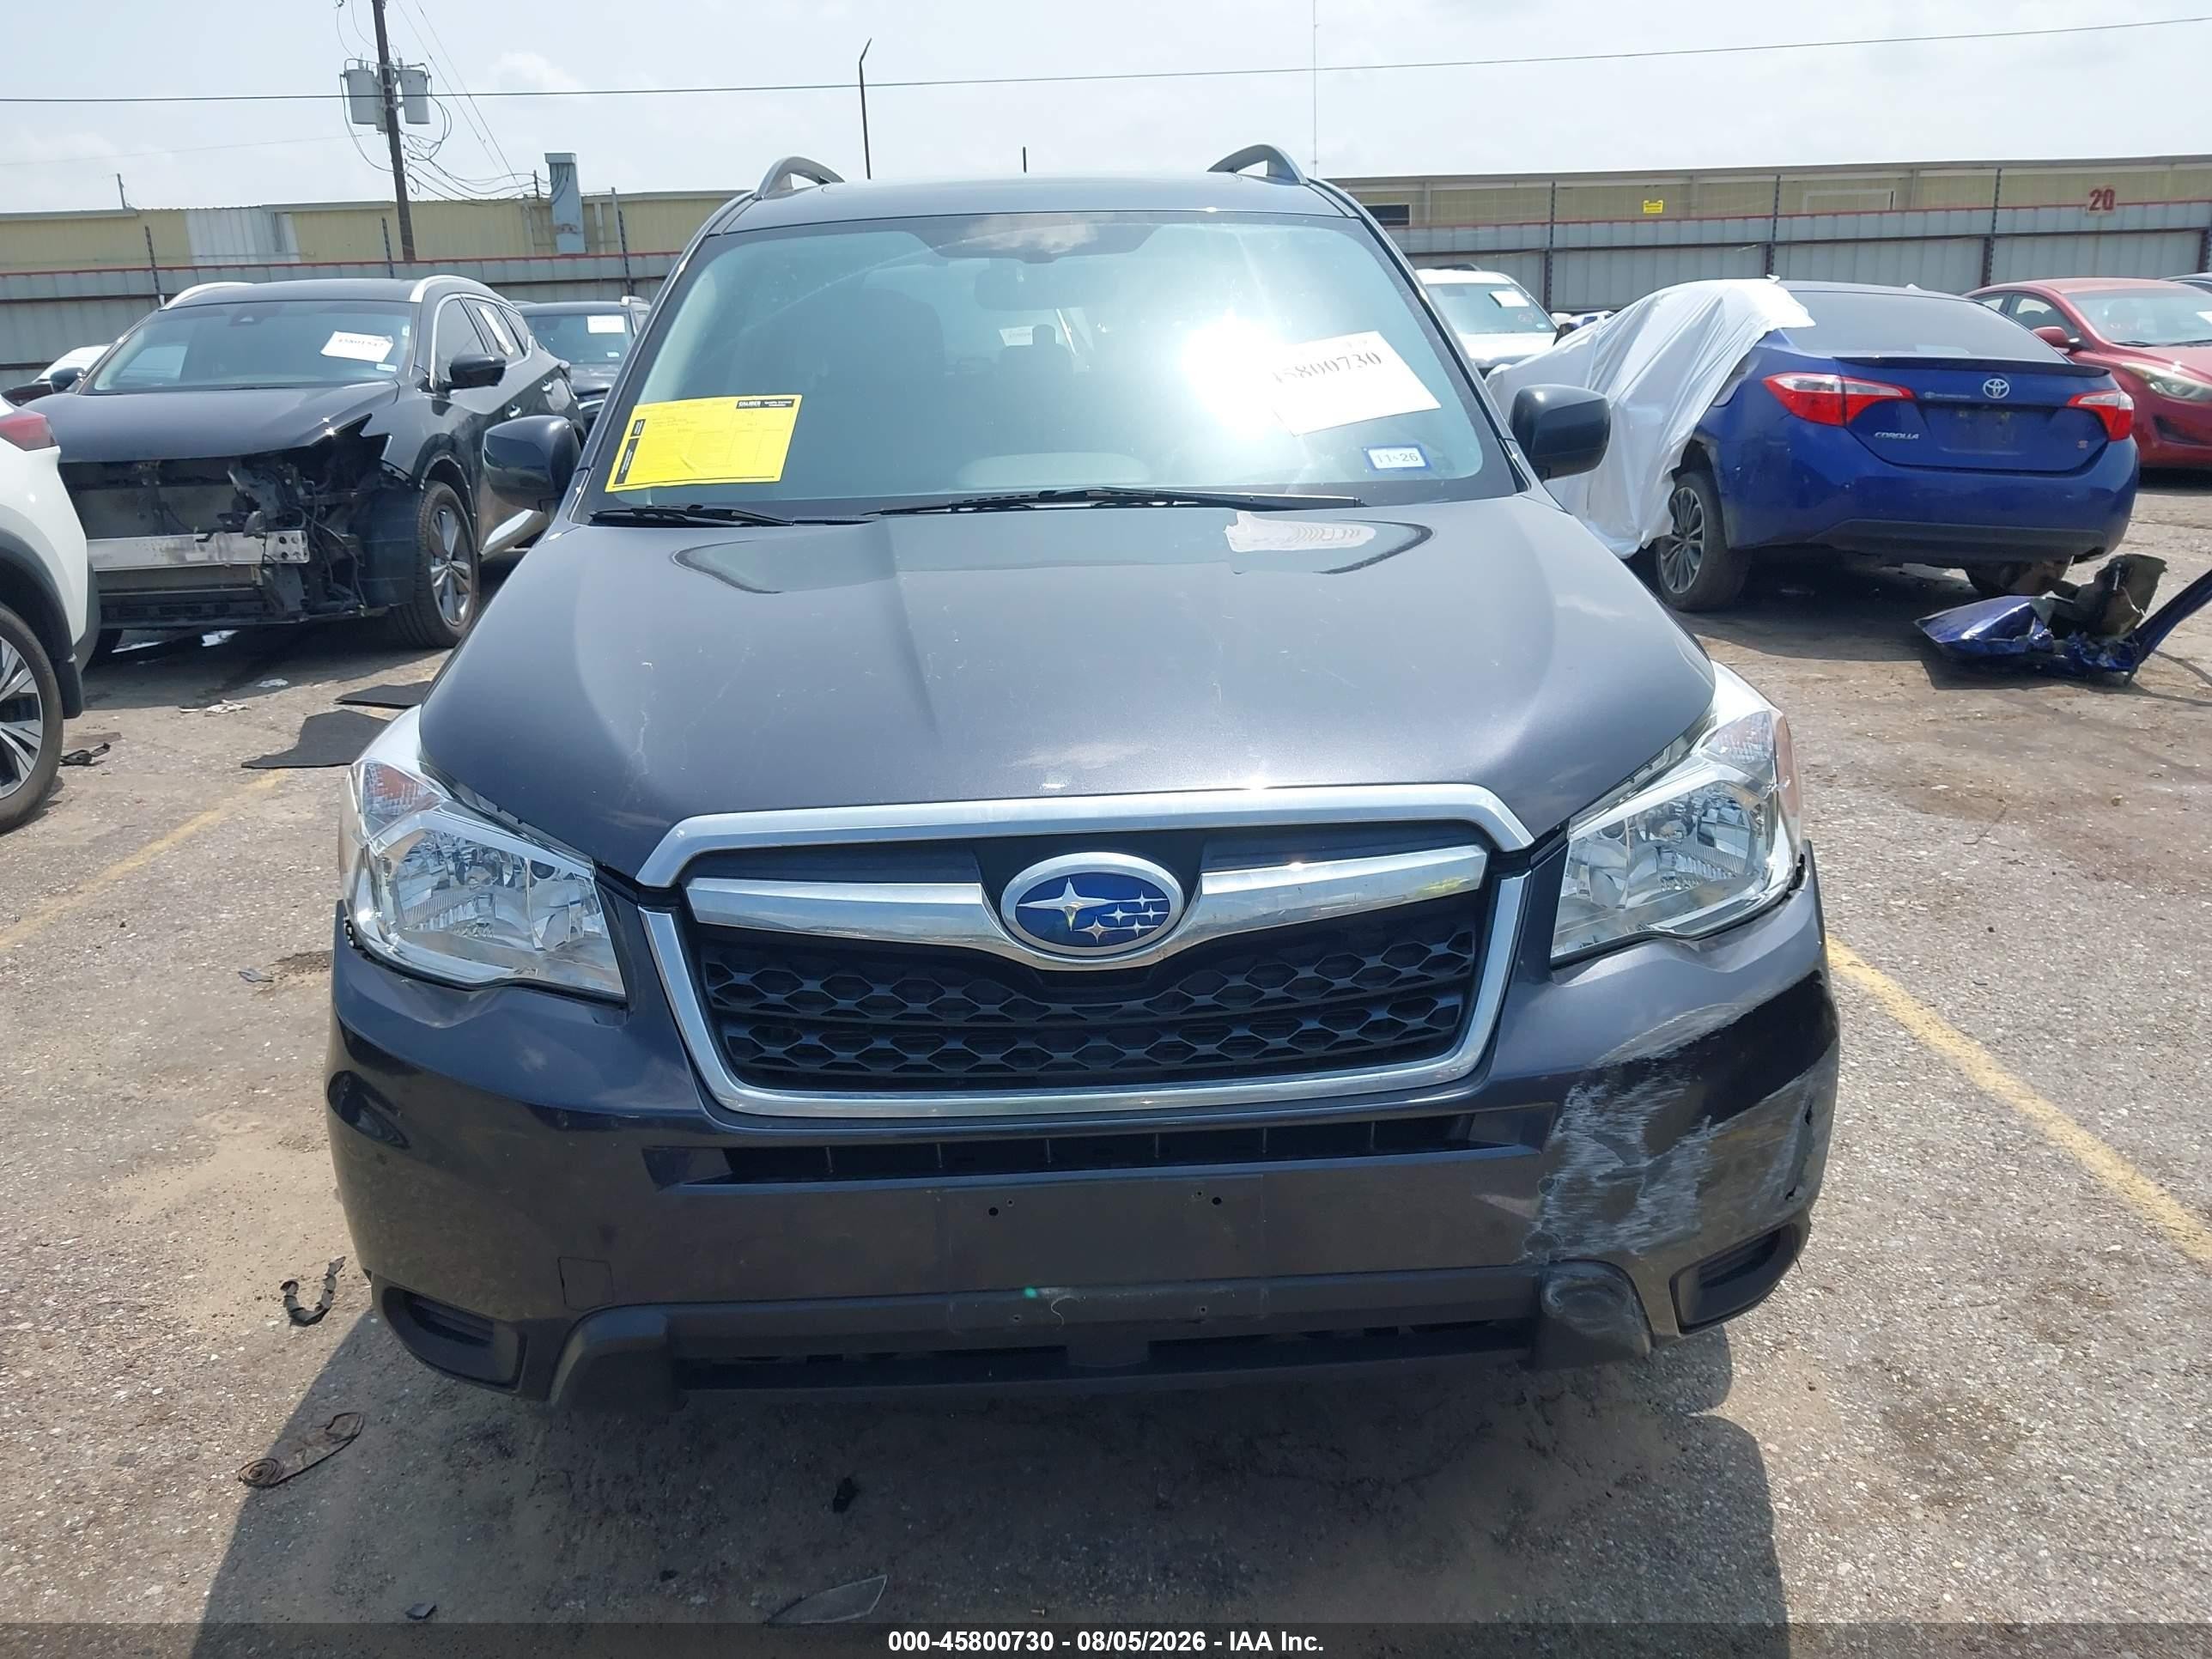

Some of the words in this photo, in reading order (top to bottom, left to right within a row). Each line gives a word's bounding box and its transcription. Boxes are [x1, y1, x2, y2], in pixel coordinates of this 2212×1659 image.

[2088, 188, 2115, 211] 20
[1272, 351, 1382, 383] 800730
[1875, 431, 1920, 440] COROLLA
